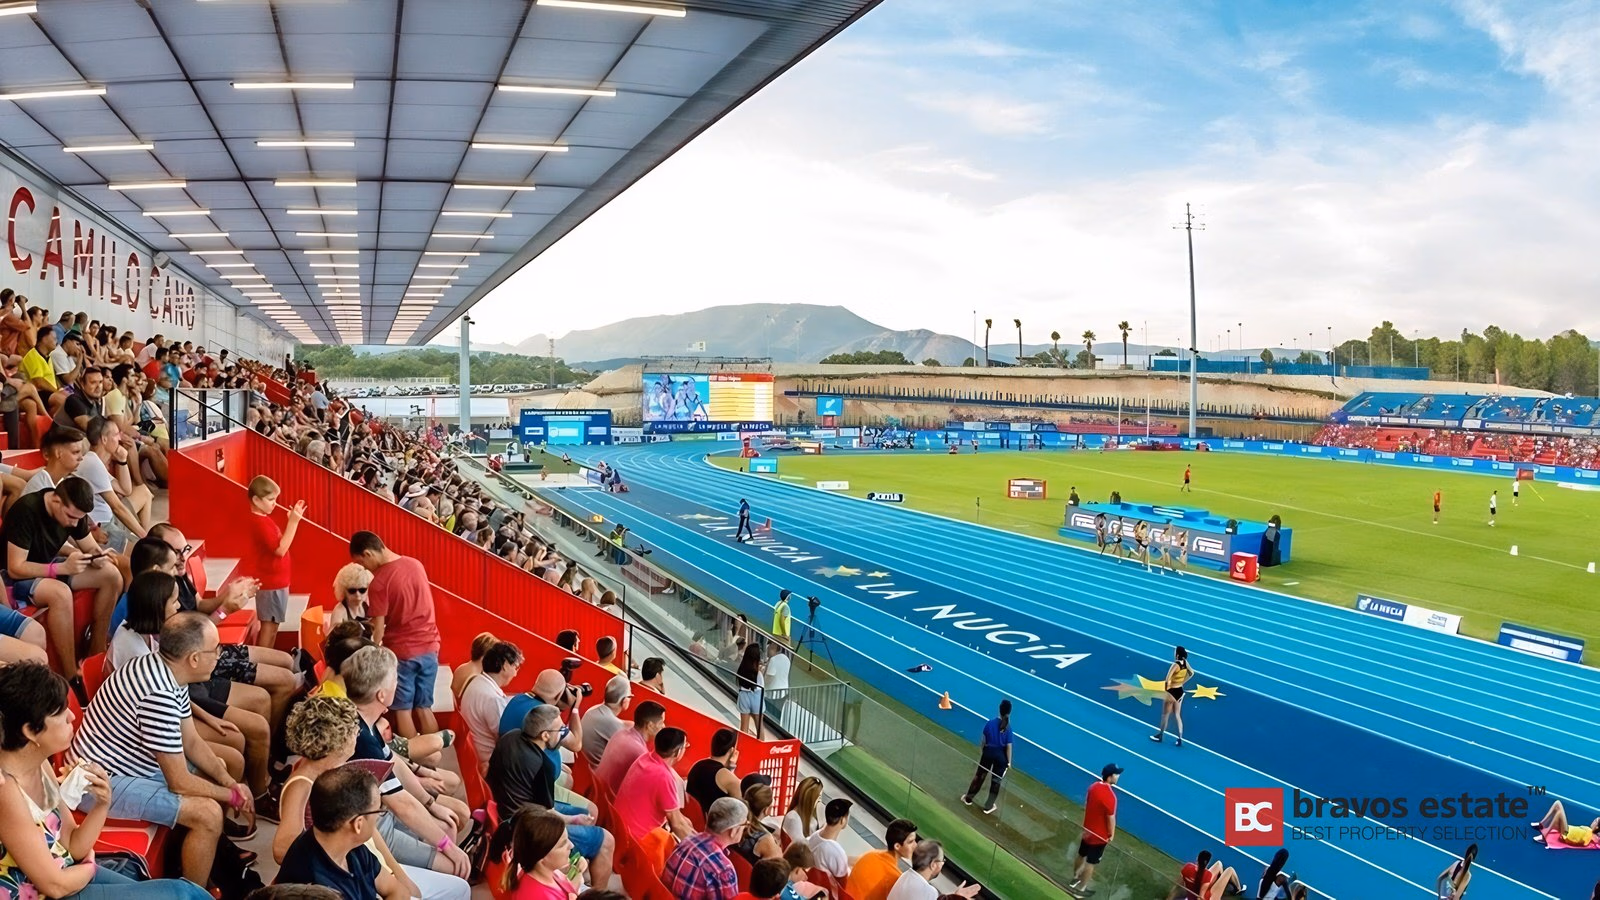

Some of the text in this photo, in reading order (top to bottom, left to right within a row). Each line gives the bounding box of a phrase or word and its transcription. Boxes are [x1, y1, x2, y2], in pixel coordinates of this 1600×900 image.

[7, 186, 196, 331] CAMILO CANO
[854, 583, 919, 600] LA
